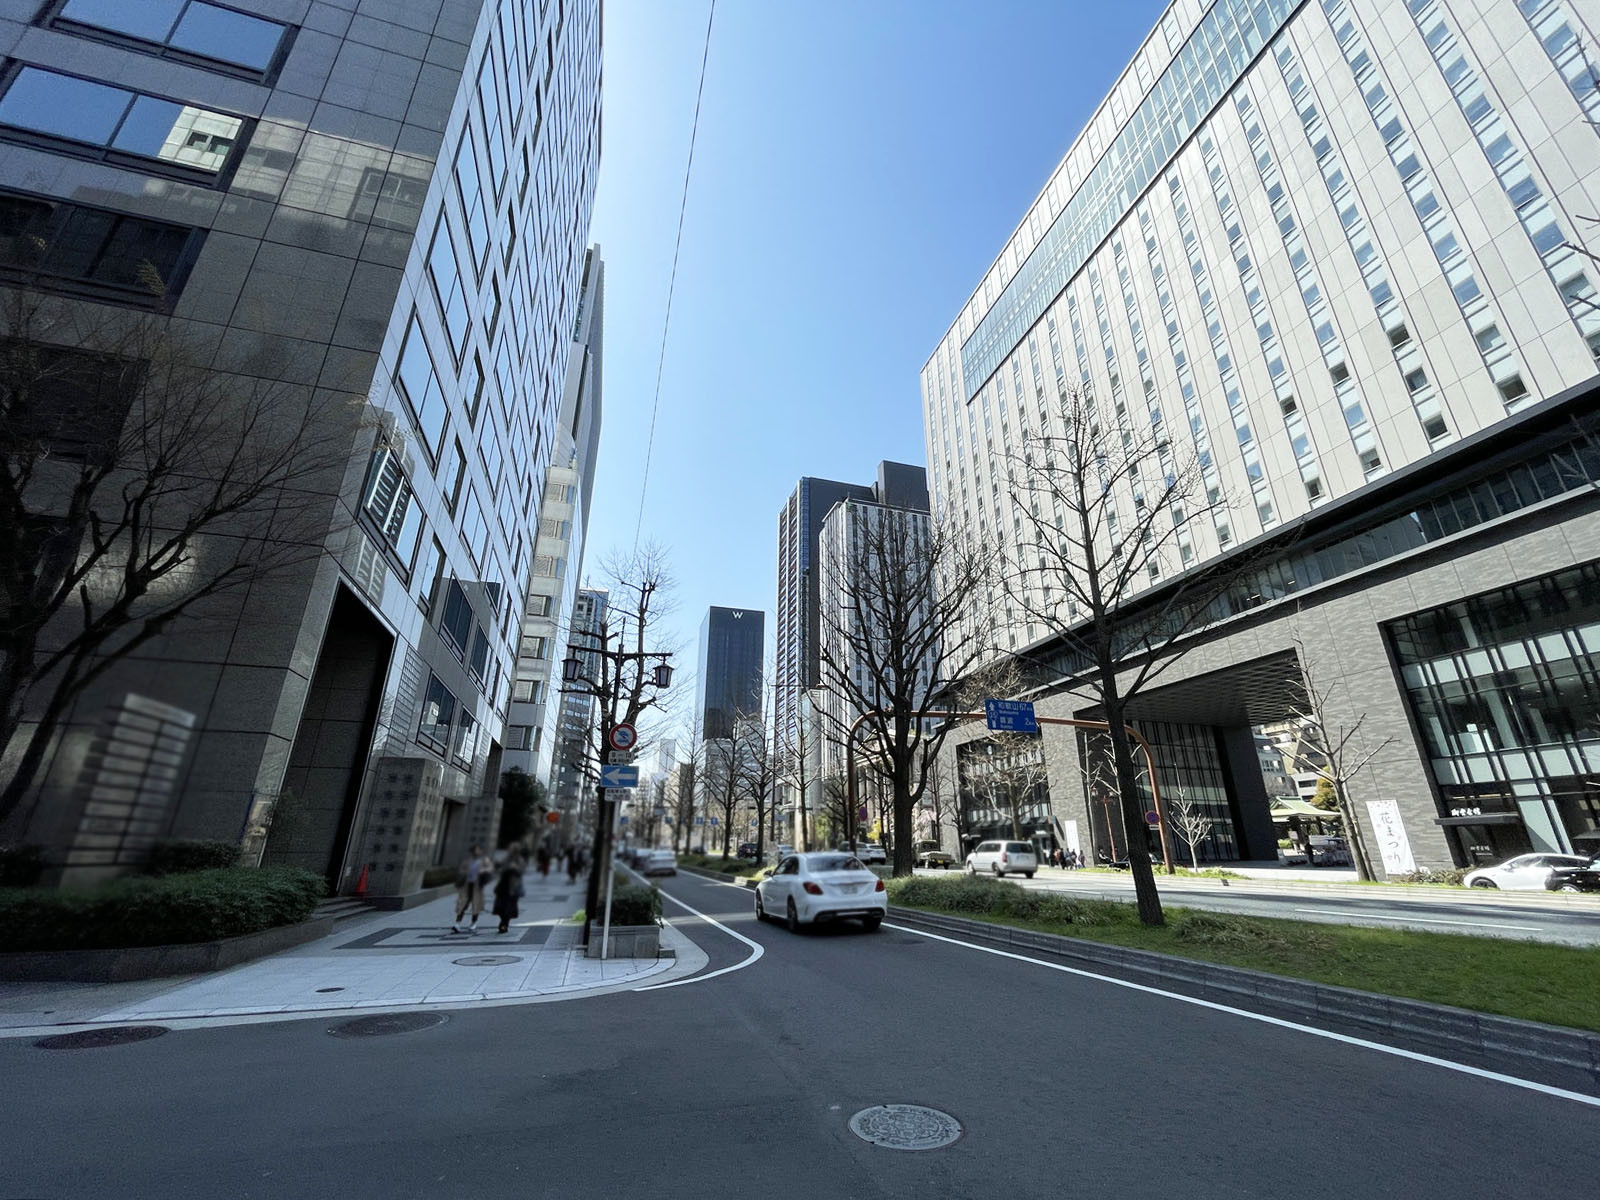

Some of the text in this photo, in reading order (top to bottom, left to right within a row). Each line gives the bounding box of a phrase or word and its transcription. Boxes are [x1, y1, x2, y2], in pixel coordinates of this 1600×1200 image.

[732, 611, 744, 619] W
[1379, 811, 1402, 864] 花まつり
